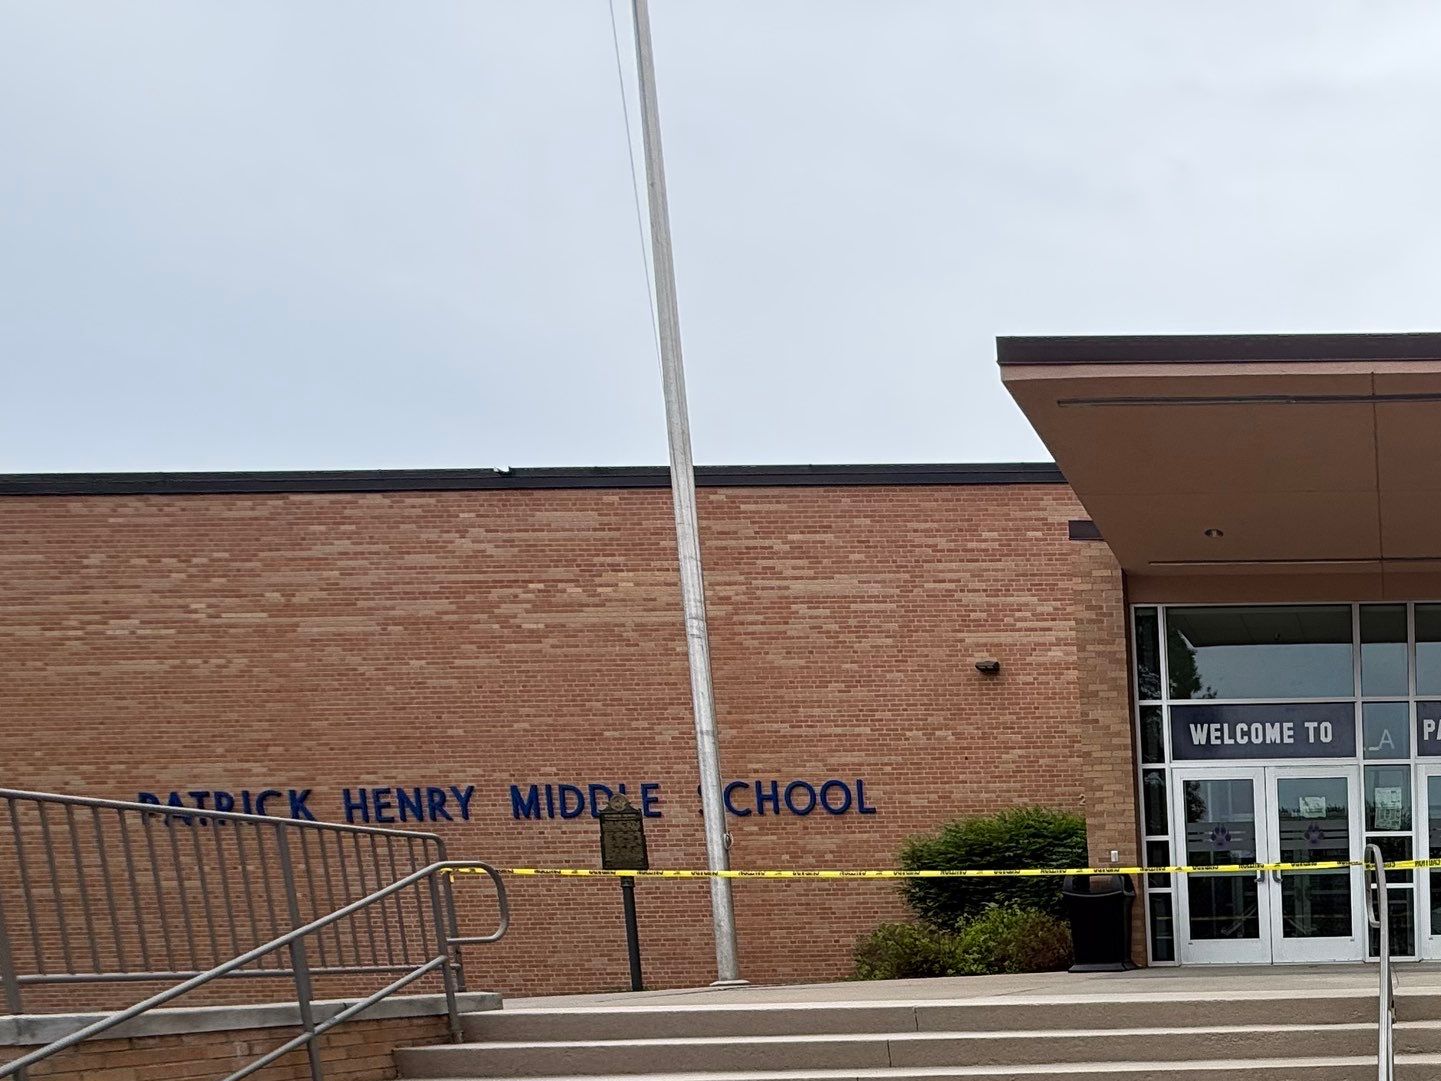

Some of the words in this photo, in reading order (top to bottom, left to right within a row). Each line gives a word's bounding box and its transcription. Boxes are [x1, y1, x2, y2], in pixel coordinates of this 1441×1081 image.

[1189, 722, 1295, 746] WELCOME
[1304, 721, 1333, 744] TO
[341, 784, 476, 824] HENRY
[509, 782, 663, 820] MIDDE
[697, 778, 878, 817] CHOOL
